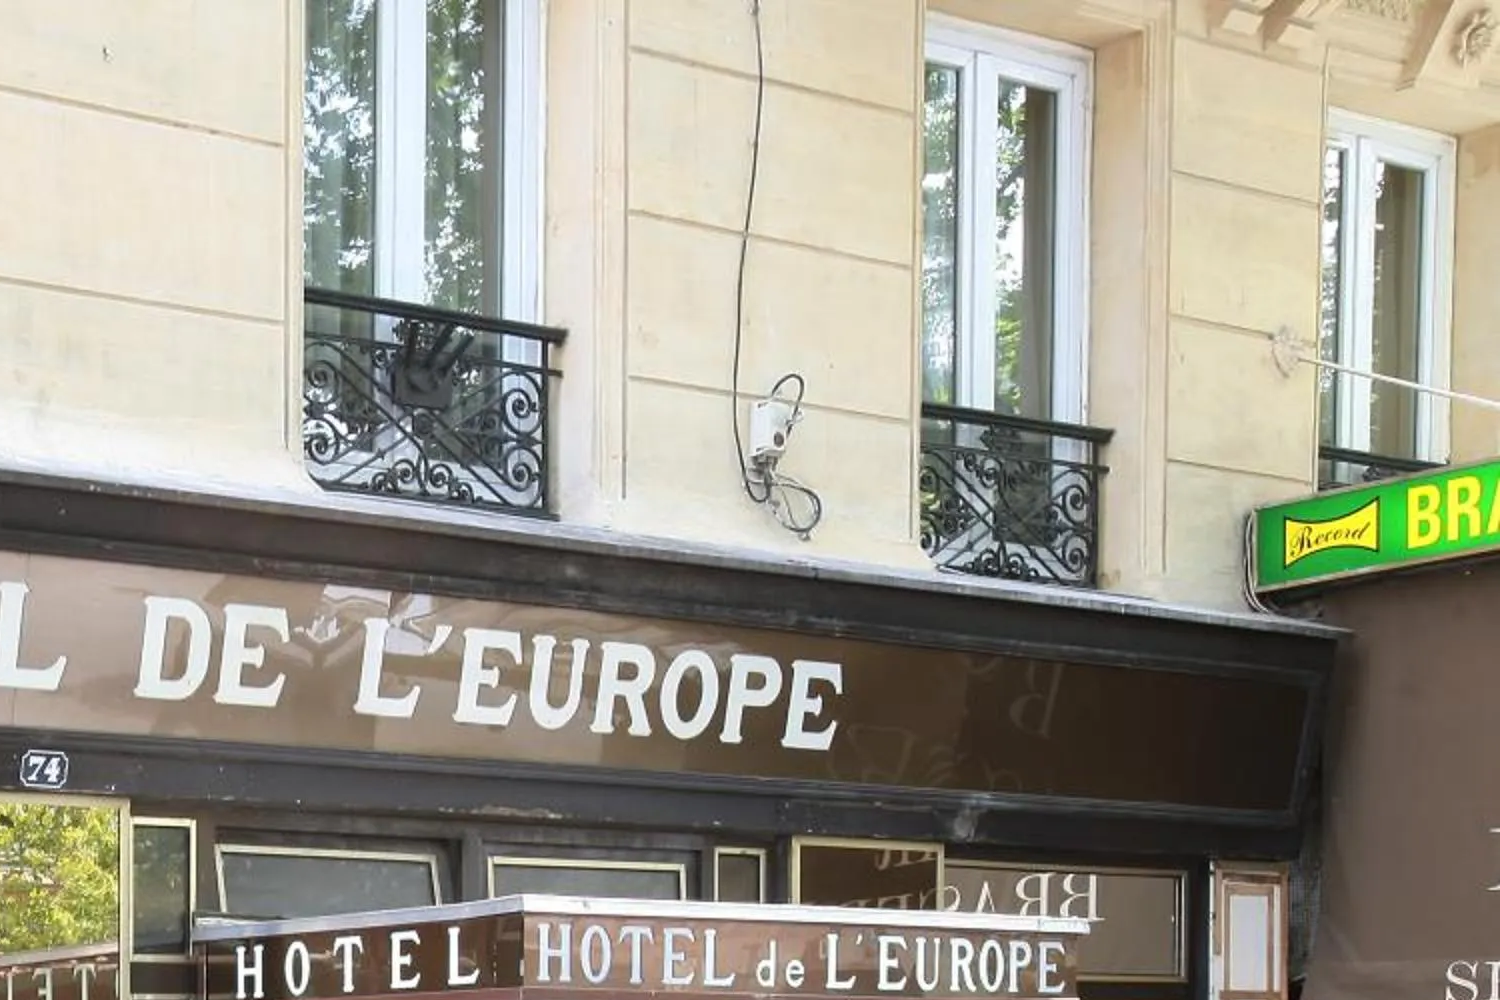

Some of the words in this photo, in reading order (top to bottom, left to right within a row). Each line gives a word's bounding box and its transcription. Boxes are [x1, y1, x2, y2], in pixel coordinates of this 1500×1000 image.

[1290, 521, 1371, 558] Record
[133, 596, 290, 706] DE
[353, 617, 844, 750] L'EUROPE
[28, 756, 61, 782] 74
[236, 926, 480, 999] HOTEL
[536, 923, 735, 987] HOTEL
[756, 941, 804, 987] de
[826, 932, 1066, 992] L'EUROPE
